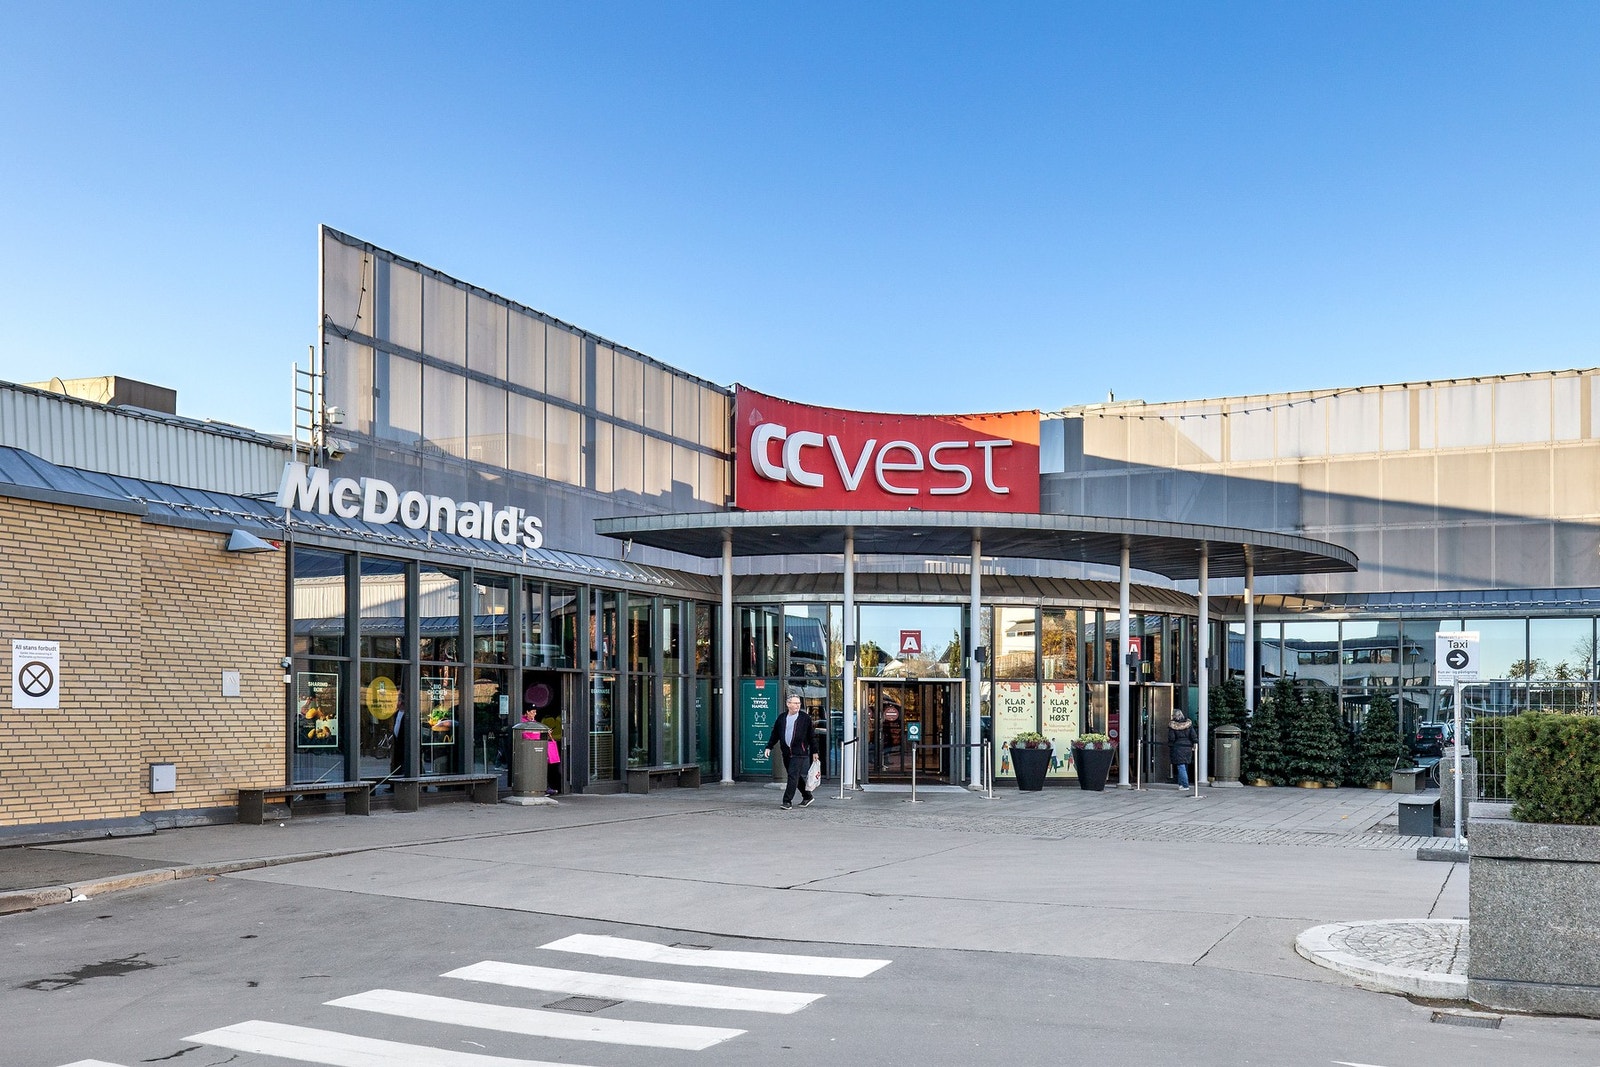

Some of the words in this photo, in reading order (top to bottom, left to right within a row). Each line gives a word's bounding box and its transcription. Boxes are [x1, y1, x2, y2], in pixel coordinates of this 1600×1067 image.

[275, 461, 543, 549] McDonald's
[903, 636, 919, 650] A
[1448, 640, 1468, 648] Taxi
[1004, 698, 1026, 706] KLAR
